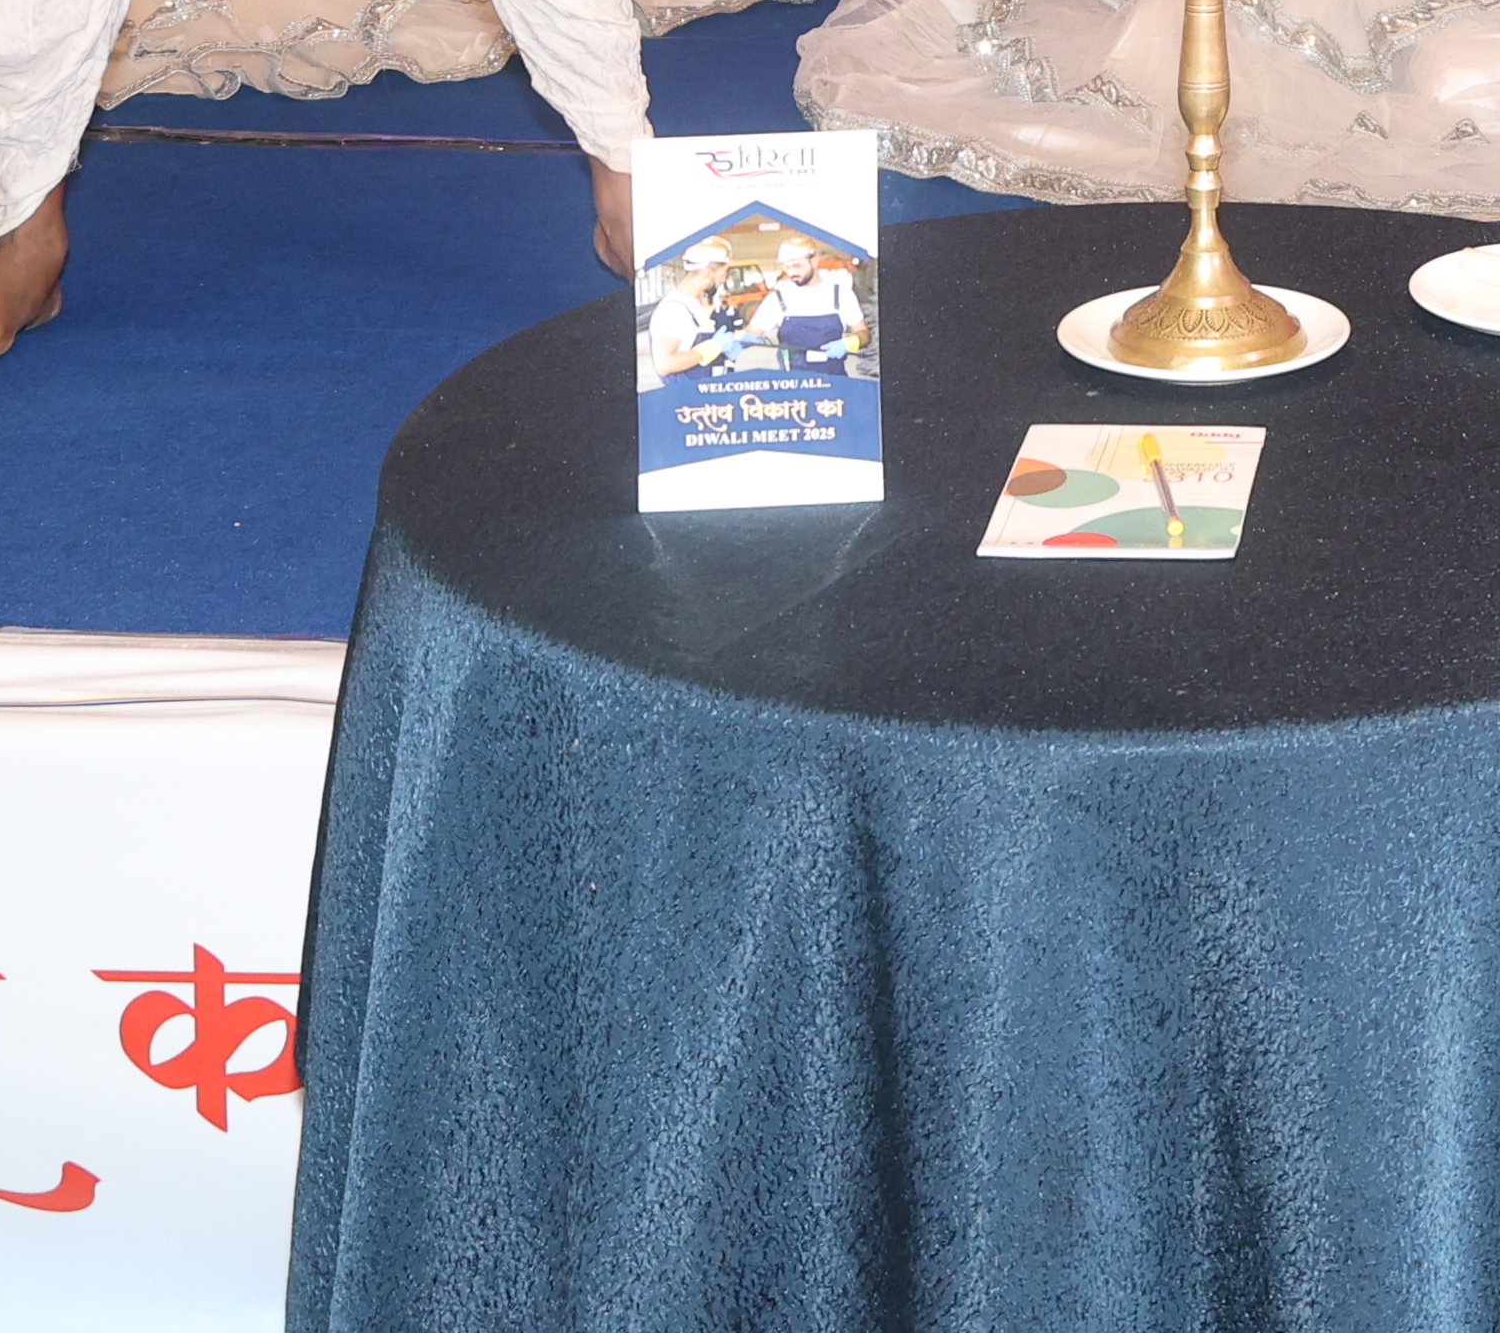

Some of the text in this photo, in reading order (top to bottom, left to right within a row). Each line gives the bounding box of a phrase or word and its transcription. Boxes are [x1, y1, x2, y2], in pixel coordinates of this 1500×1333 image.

[789, 168, 817, 177] TMT
[697, 380, 771, 394] WELCOMES
[771, 379, 799, 391] YOU
[815, 398, 845, 418] का
[685, 427, 836, 447] DIWALI MEET 2025
